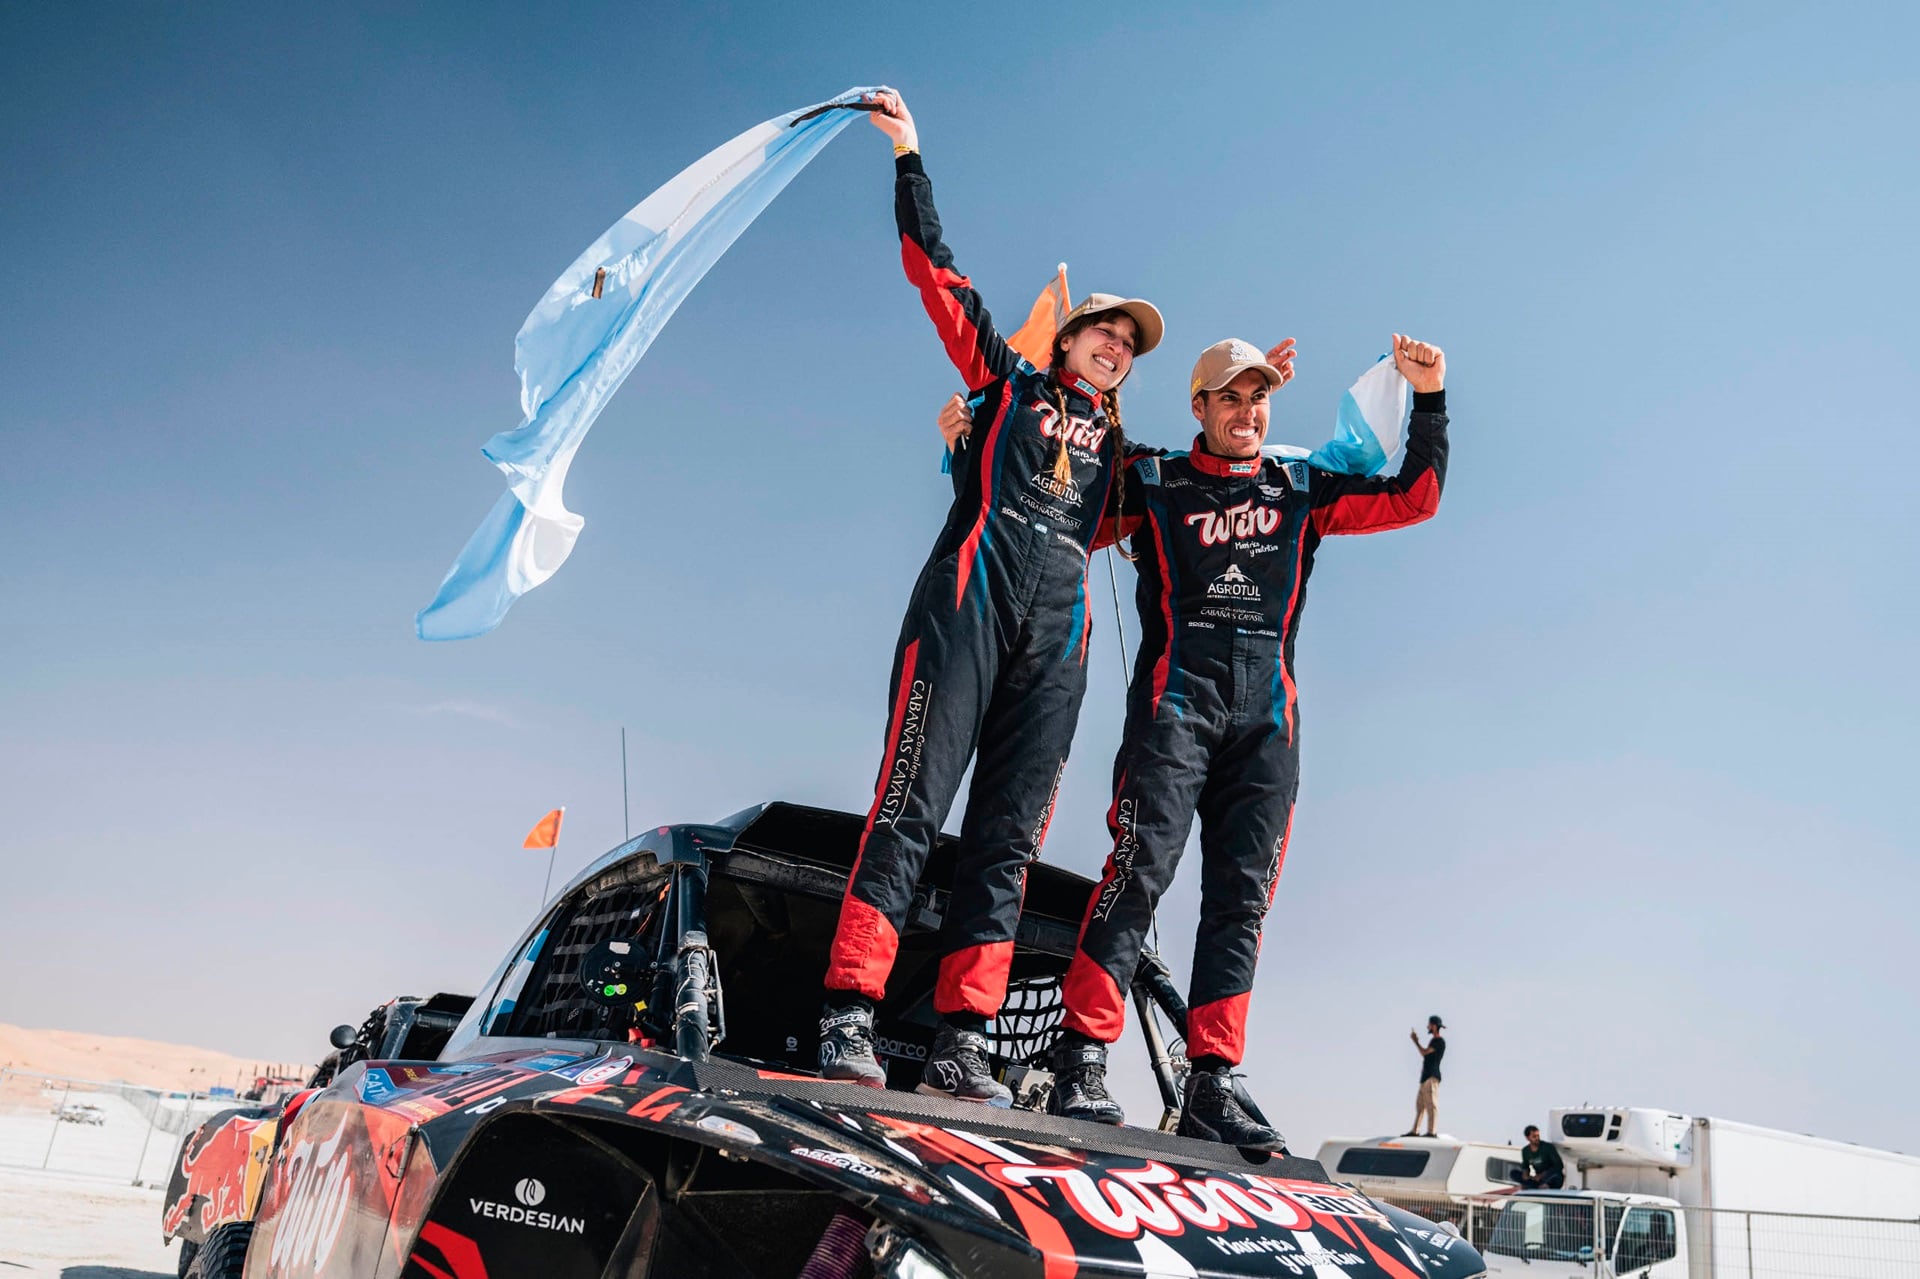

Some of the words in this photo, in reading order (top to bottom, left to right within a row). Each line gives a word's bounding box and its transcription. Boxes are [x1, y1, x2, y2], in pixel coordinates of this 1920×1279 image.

[1031, 400, 1106, 452] Win
[1184, 498, 1282, 547] Win
[1207, 583, 1261, 597] AGROTUL
[899, 679, 925, 755] CABAÑAS
[909, 734, 925, 780] Complejo
[875, 757, 910, 825] CAYASTÁ
[270, 1110, 353, 1275] Win
[470, 1198, 585, 1234] VERDESIAN
[986, 1160, 1313, 1240] Win
